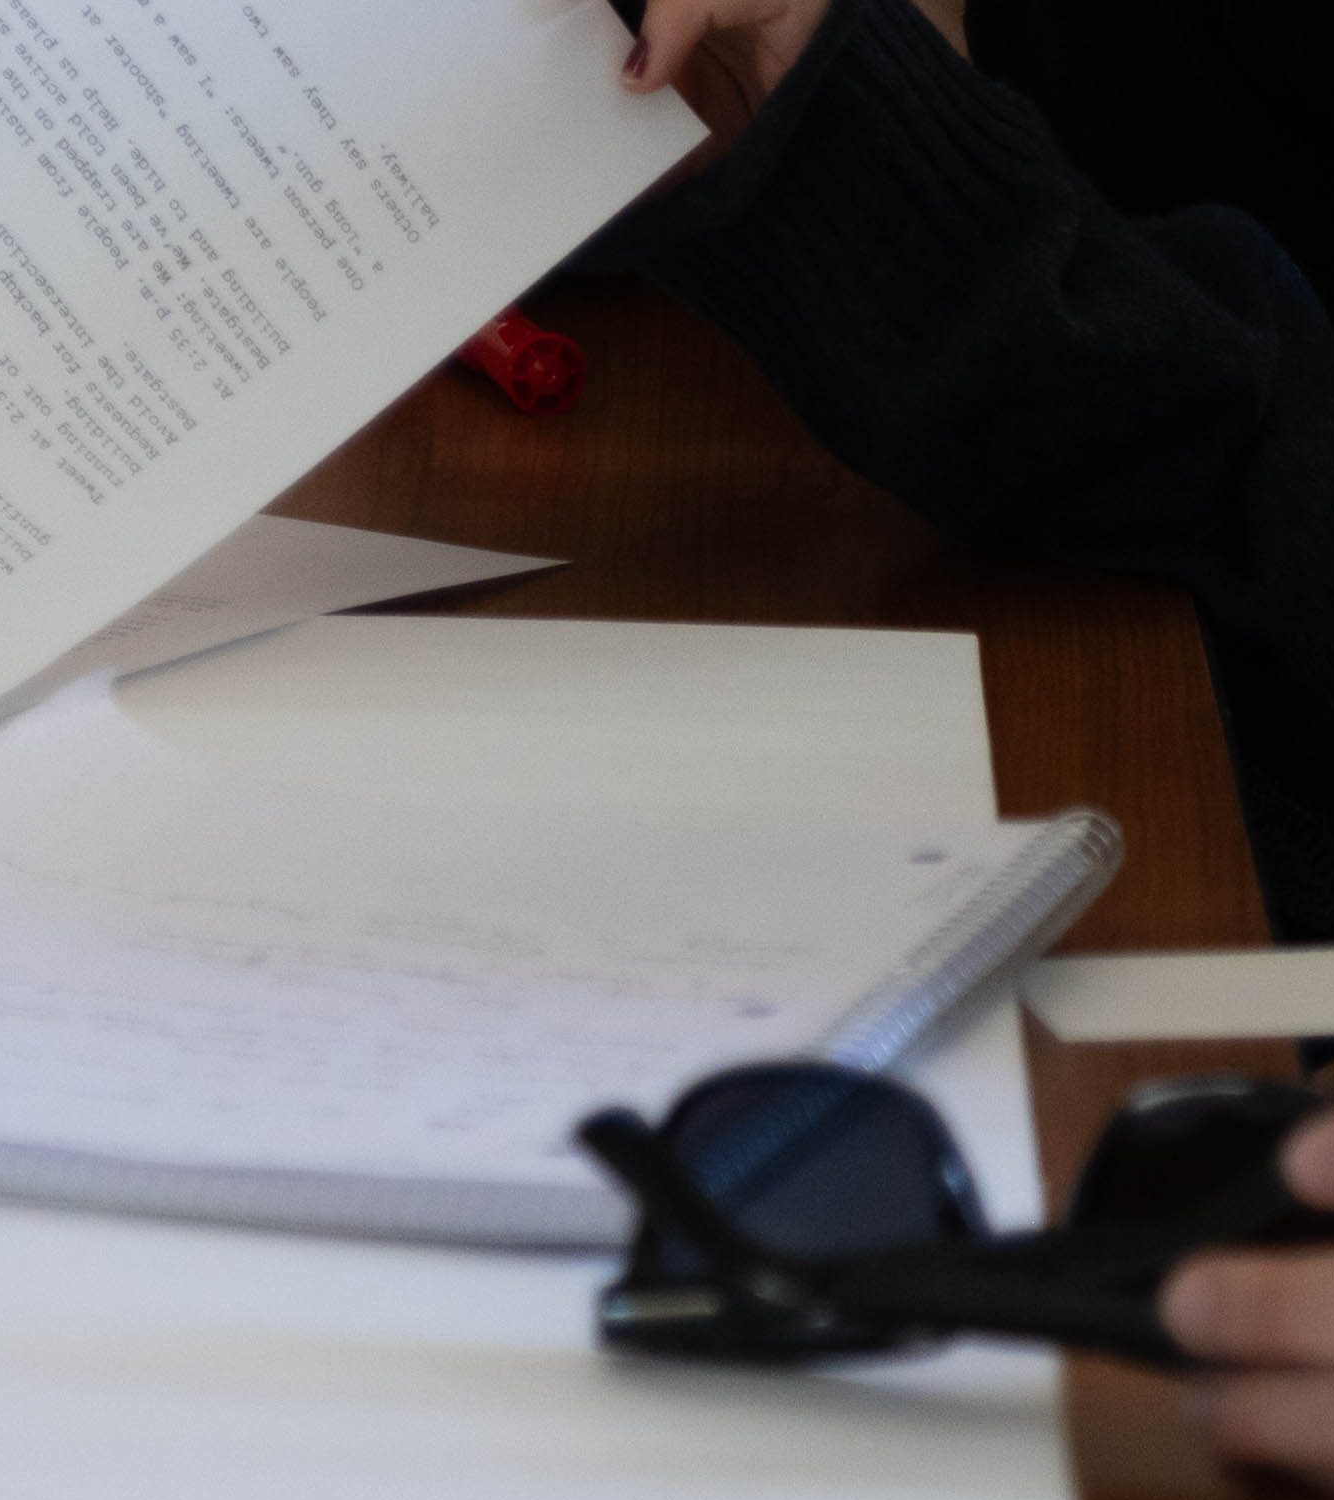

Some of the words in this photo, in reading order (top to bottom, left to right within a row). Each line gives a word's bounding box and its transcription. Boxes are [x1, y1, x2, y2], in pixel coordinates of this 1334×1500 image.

[80, 4, 102, 26] at
[153, 12, 166, 25] a
[241, 5, 269, 38] two
[167, 33, 197, 66] saw
[271, 45, 301, 78] saw
[15, 43, 67, 104] active
[301, 85, 337, 130] they
[67, 112, 105, 156] told
[224, 106, 279, 179] tweets:
[339, 137, 367, 170] say
[37, 153, 73, 197] from
[110, 163, 147, 209] been
[174, 123, 240, 210] tweeting
[380, 144, 440, 229] hallway.
[244, 216, 272, 249] are
[283, 185, 337, 250] person
[370, 178, 420, 243] Others
[77, 204, 129, 270] People
[336, 256, 364, 290] One
[371, 260, 383, 273] a
[138, 277, 172, 321] p.m.
[274, 256, 327, 322] People
[200, 277, 272, 370] Bestgate.
[51, 341, 82, 374] for
[168, 328, 207, 371] 2:35
[98, 355, 124, 389] the
[123, 341, 198, 431] Bestgate.
[212, 376, 234, 400] At
[30, 428, 51, 449] at
[64, 389, 143, 476] building.
[85, 381, 160, 460] Requests
[127, 394, 179, 445] Avoid
[56, 457, 104, 505] Tweet
